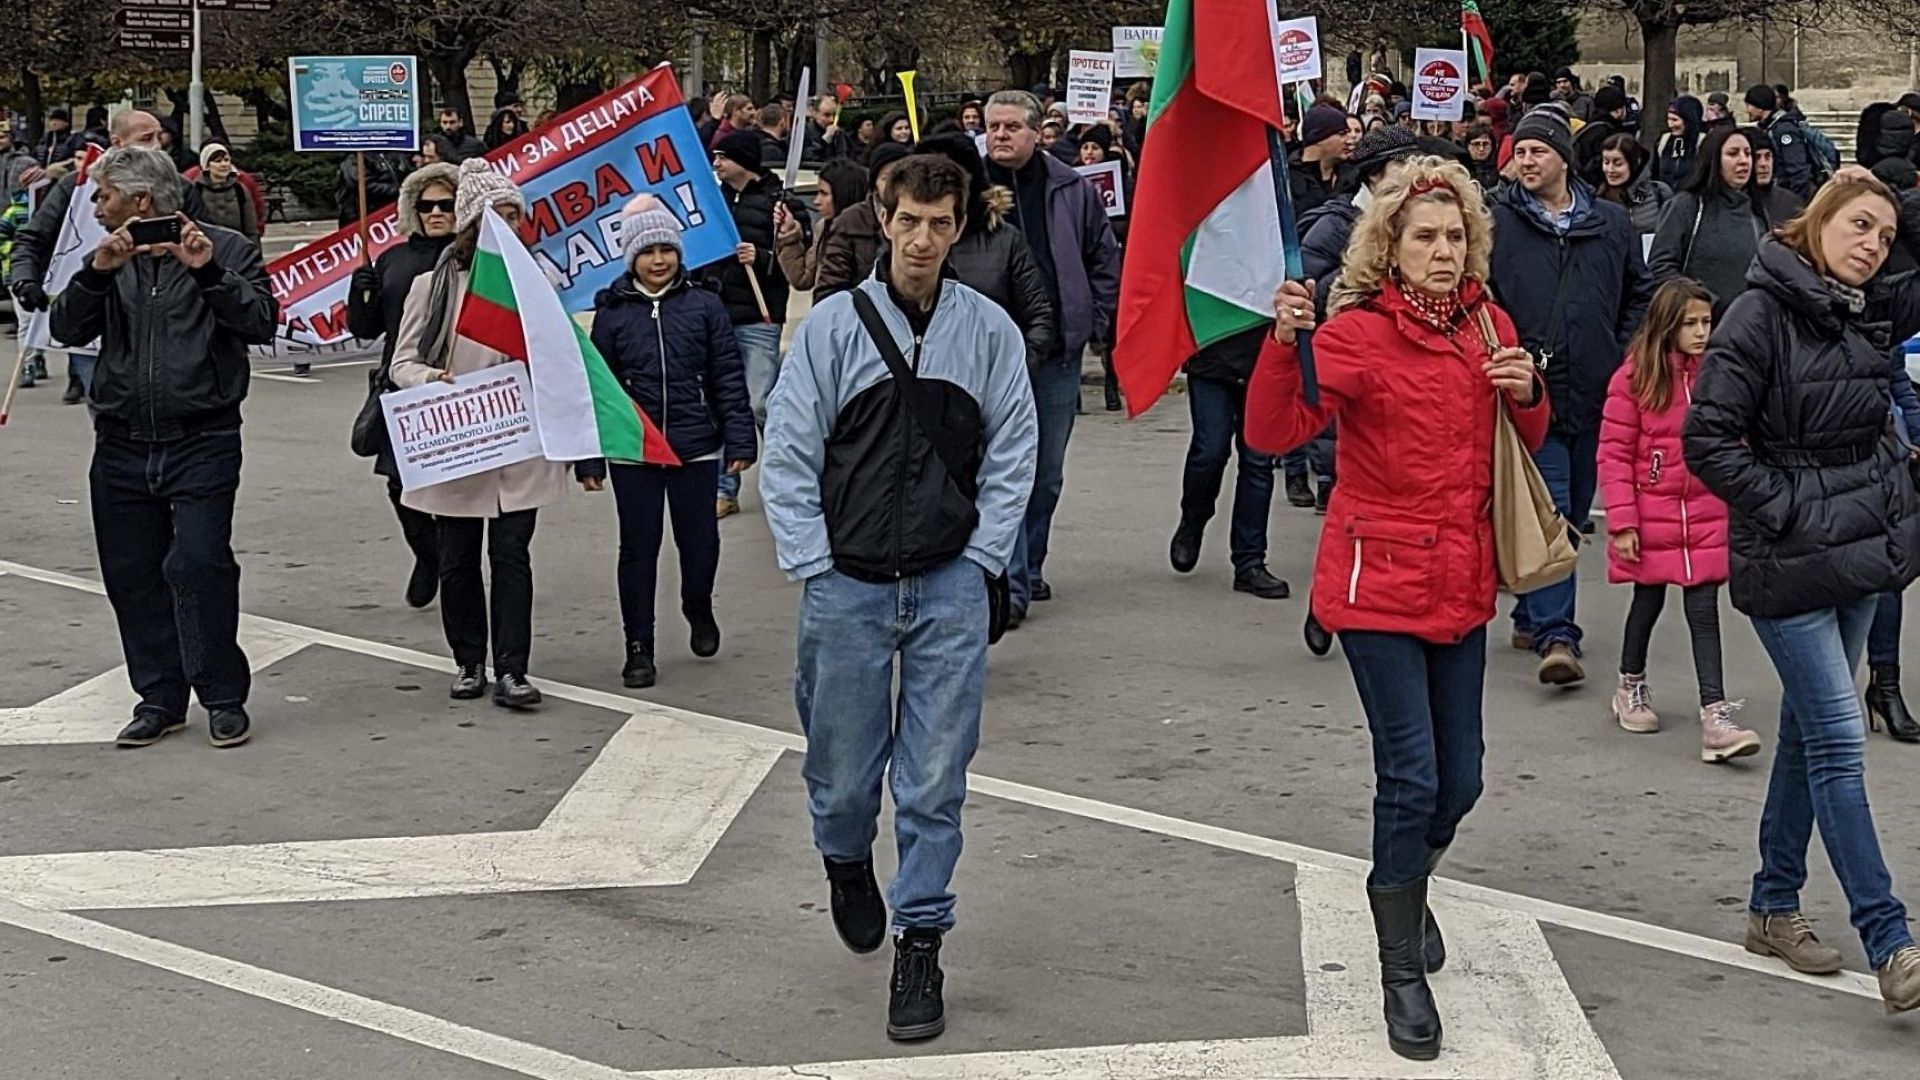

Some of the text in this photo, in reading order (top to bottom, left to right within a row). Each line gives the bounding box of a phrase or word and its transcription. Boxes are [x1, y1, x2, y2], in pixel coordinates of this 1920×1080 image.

[1071, 57, 1112, 70] ПРОТЕСТ
[359, 103, 410, 122] СПРЕТЕ!
[522, 135, 559, 164] ЗА
[560, 85, 655, 152] ДЕЦАТА
[635, 134, 684, 184] И
[398, 385, 527, 444] ЕДИНЕНИЕ
[404, 445, 417, 455] ЗА
[418, 427, 484, 451] СЕМЕЙСТВОТО
[494, 415, 530, 431] ДЕЦАТА
